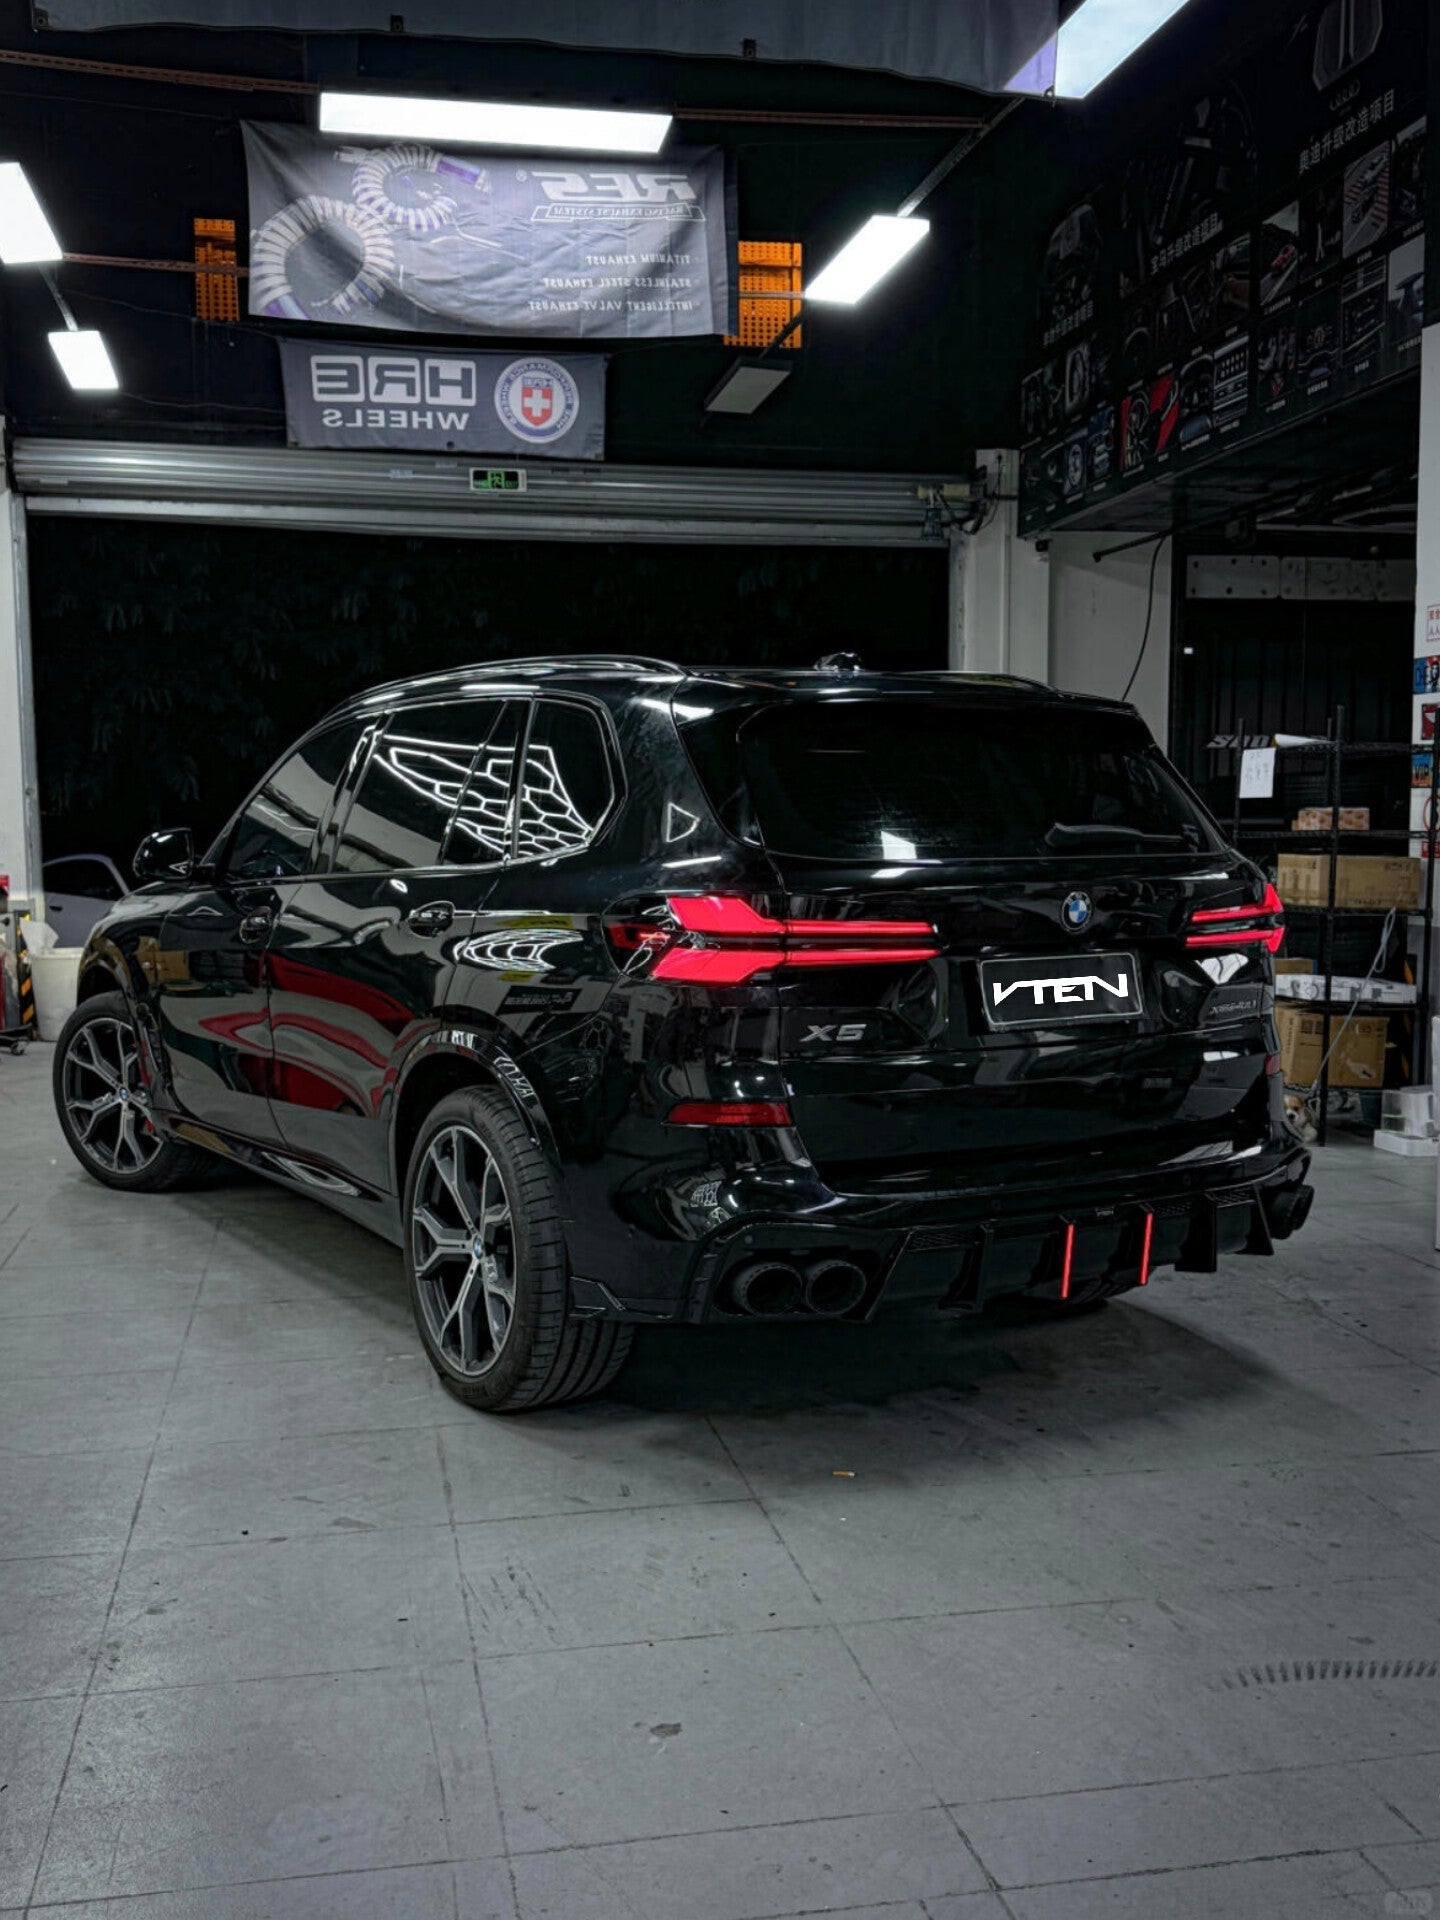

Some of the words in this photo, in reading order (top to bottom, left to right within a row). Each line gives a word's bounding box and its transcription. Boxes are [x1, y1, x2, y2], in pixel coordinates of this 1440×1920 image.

[1414, 764, 1429, 781] VIP
[992, 973, 1129, 1007] VTEN
[799, 1023, 868, 1042] X5
